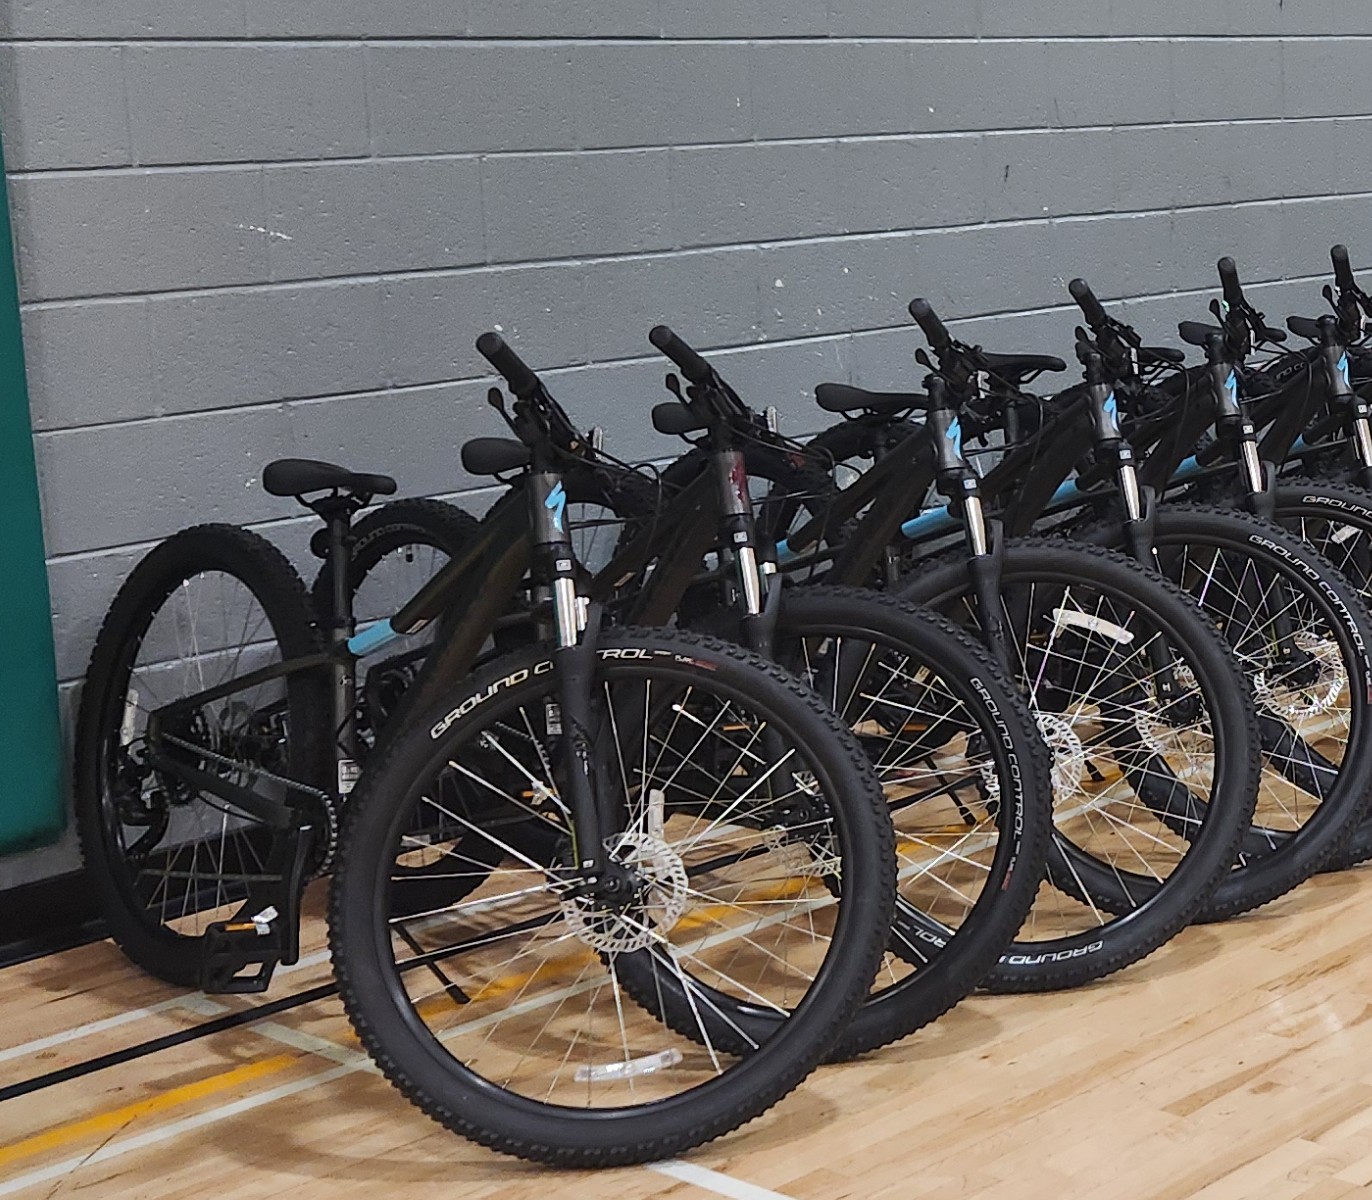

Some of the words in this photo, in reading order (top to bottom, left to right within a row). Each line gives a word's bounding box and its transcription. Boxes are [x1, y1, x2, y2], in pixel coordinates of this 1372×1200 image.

[1249, 534, 1321, 581] GROUND
[1318, 581, 1366, 657] CONTROL
[430, 669, 529, 740] GROUND
[969, 677, 1014, 750] GROUND
[1007, 753, 1024, 840] CONTROL
[1009, 940, 1104, 965] GROUND
